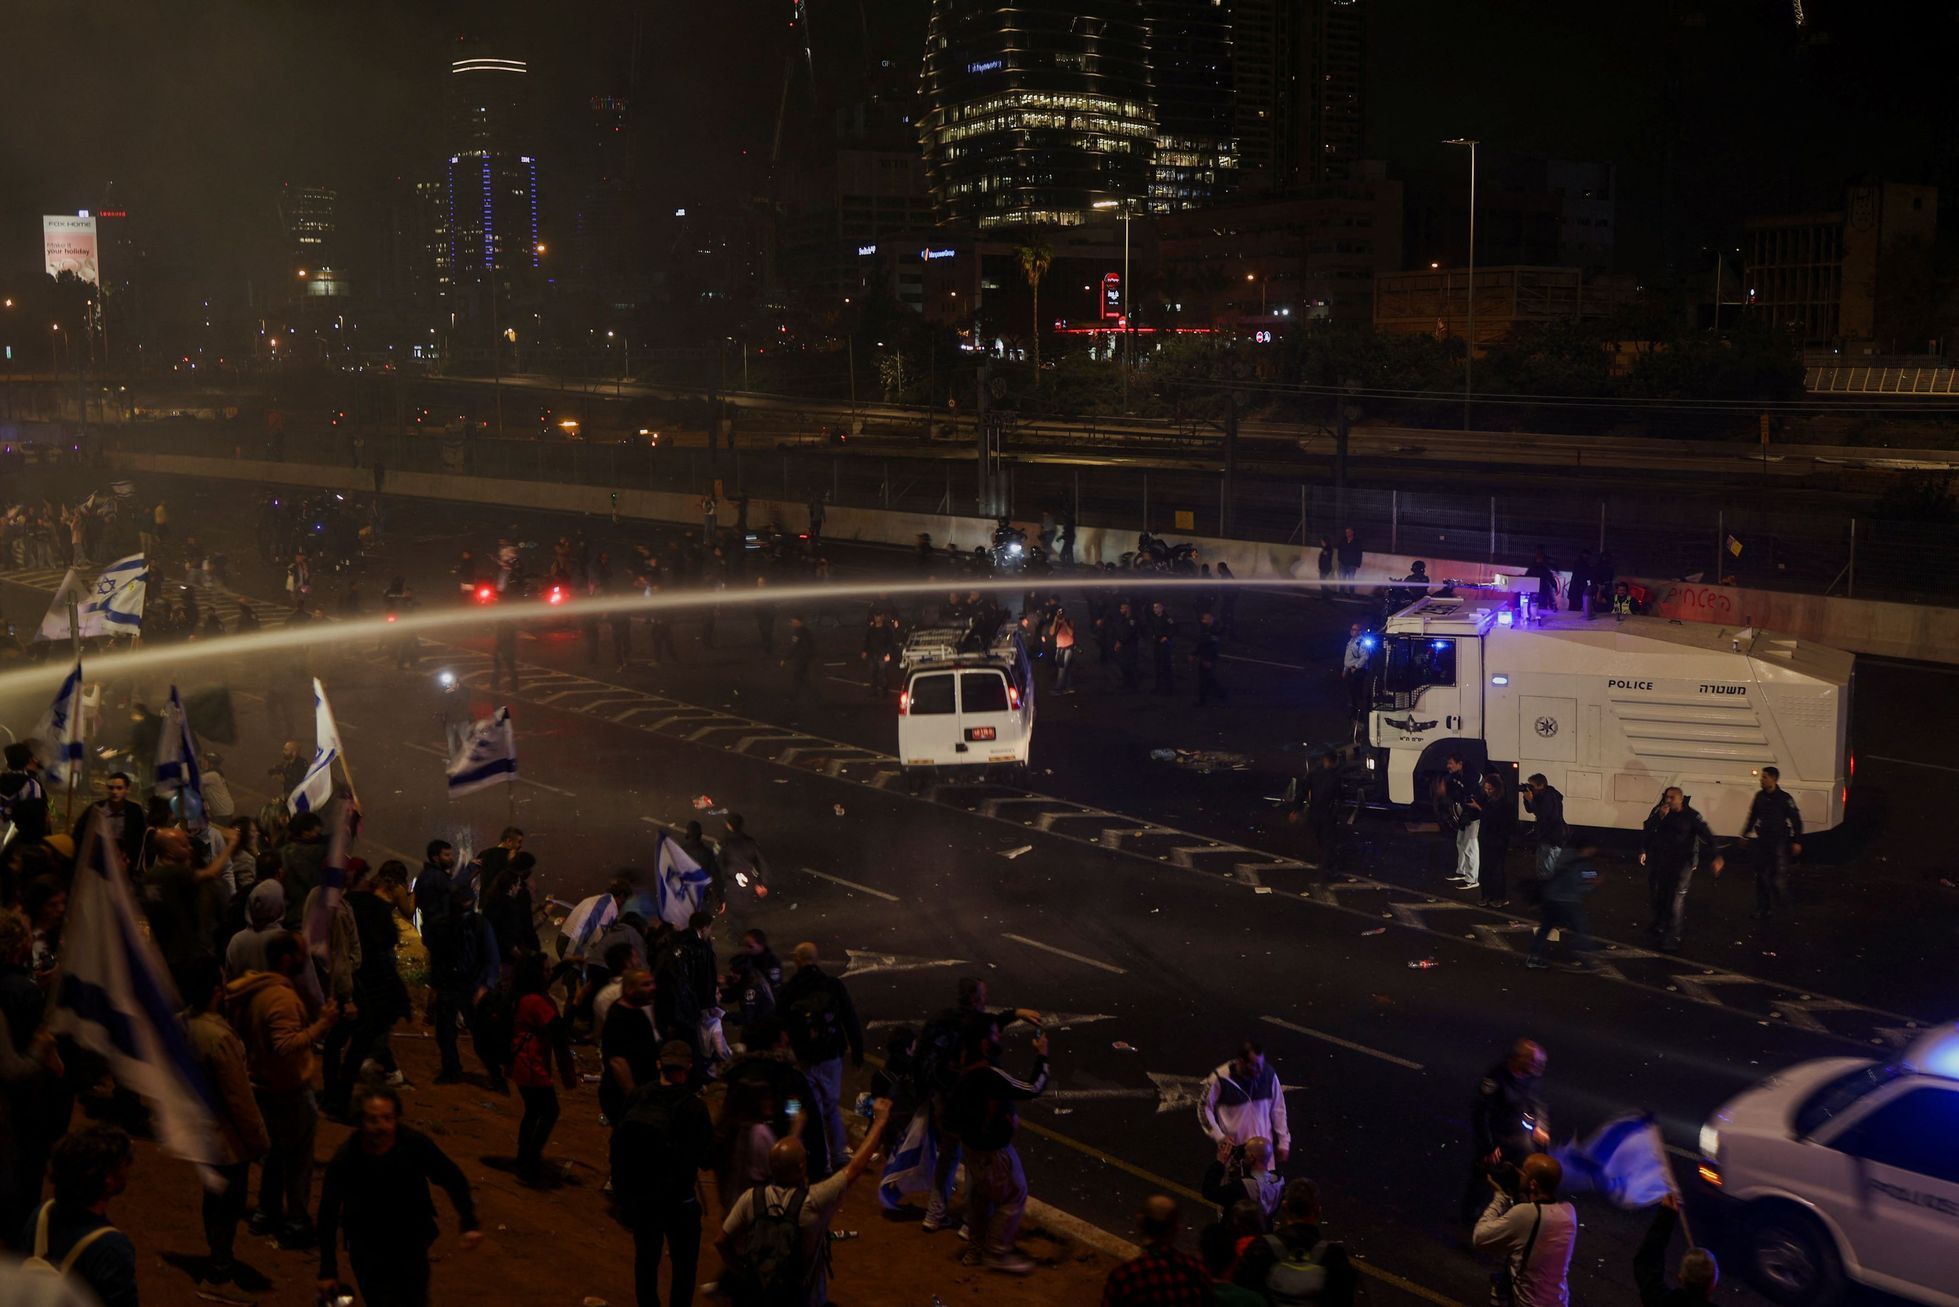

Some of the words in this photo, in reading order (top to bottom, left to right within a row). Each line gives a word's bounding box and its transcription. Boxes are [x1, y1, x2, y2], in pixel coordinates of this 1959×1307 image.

[47, 248, 62, 256] your
[64, 248, 90, 256] holiday
[1608, 679, 1653, 690] POLICE
[1699, 684, 1747, 695] משטרה
